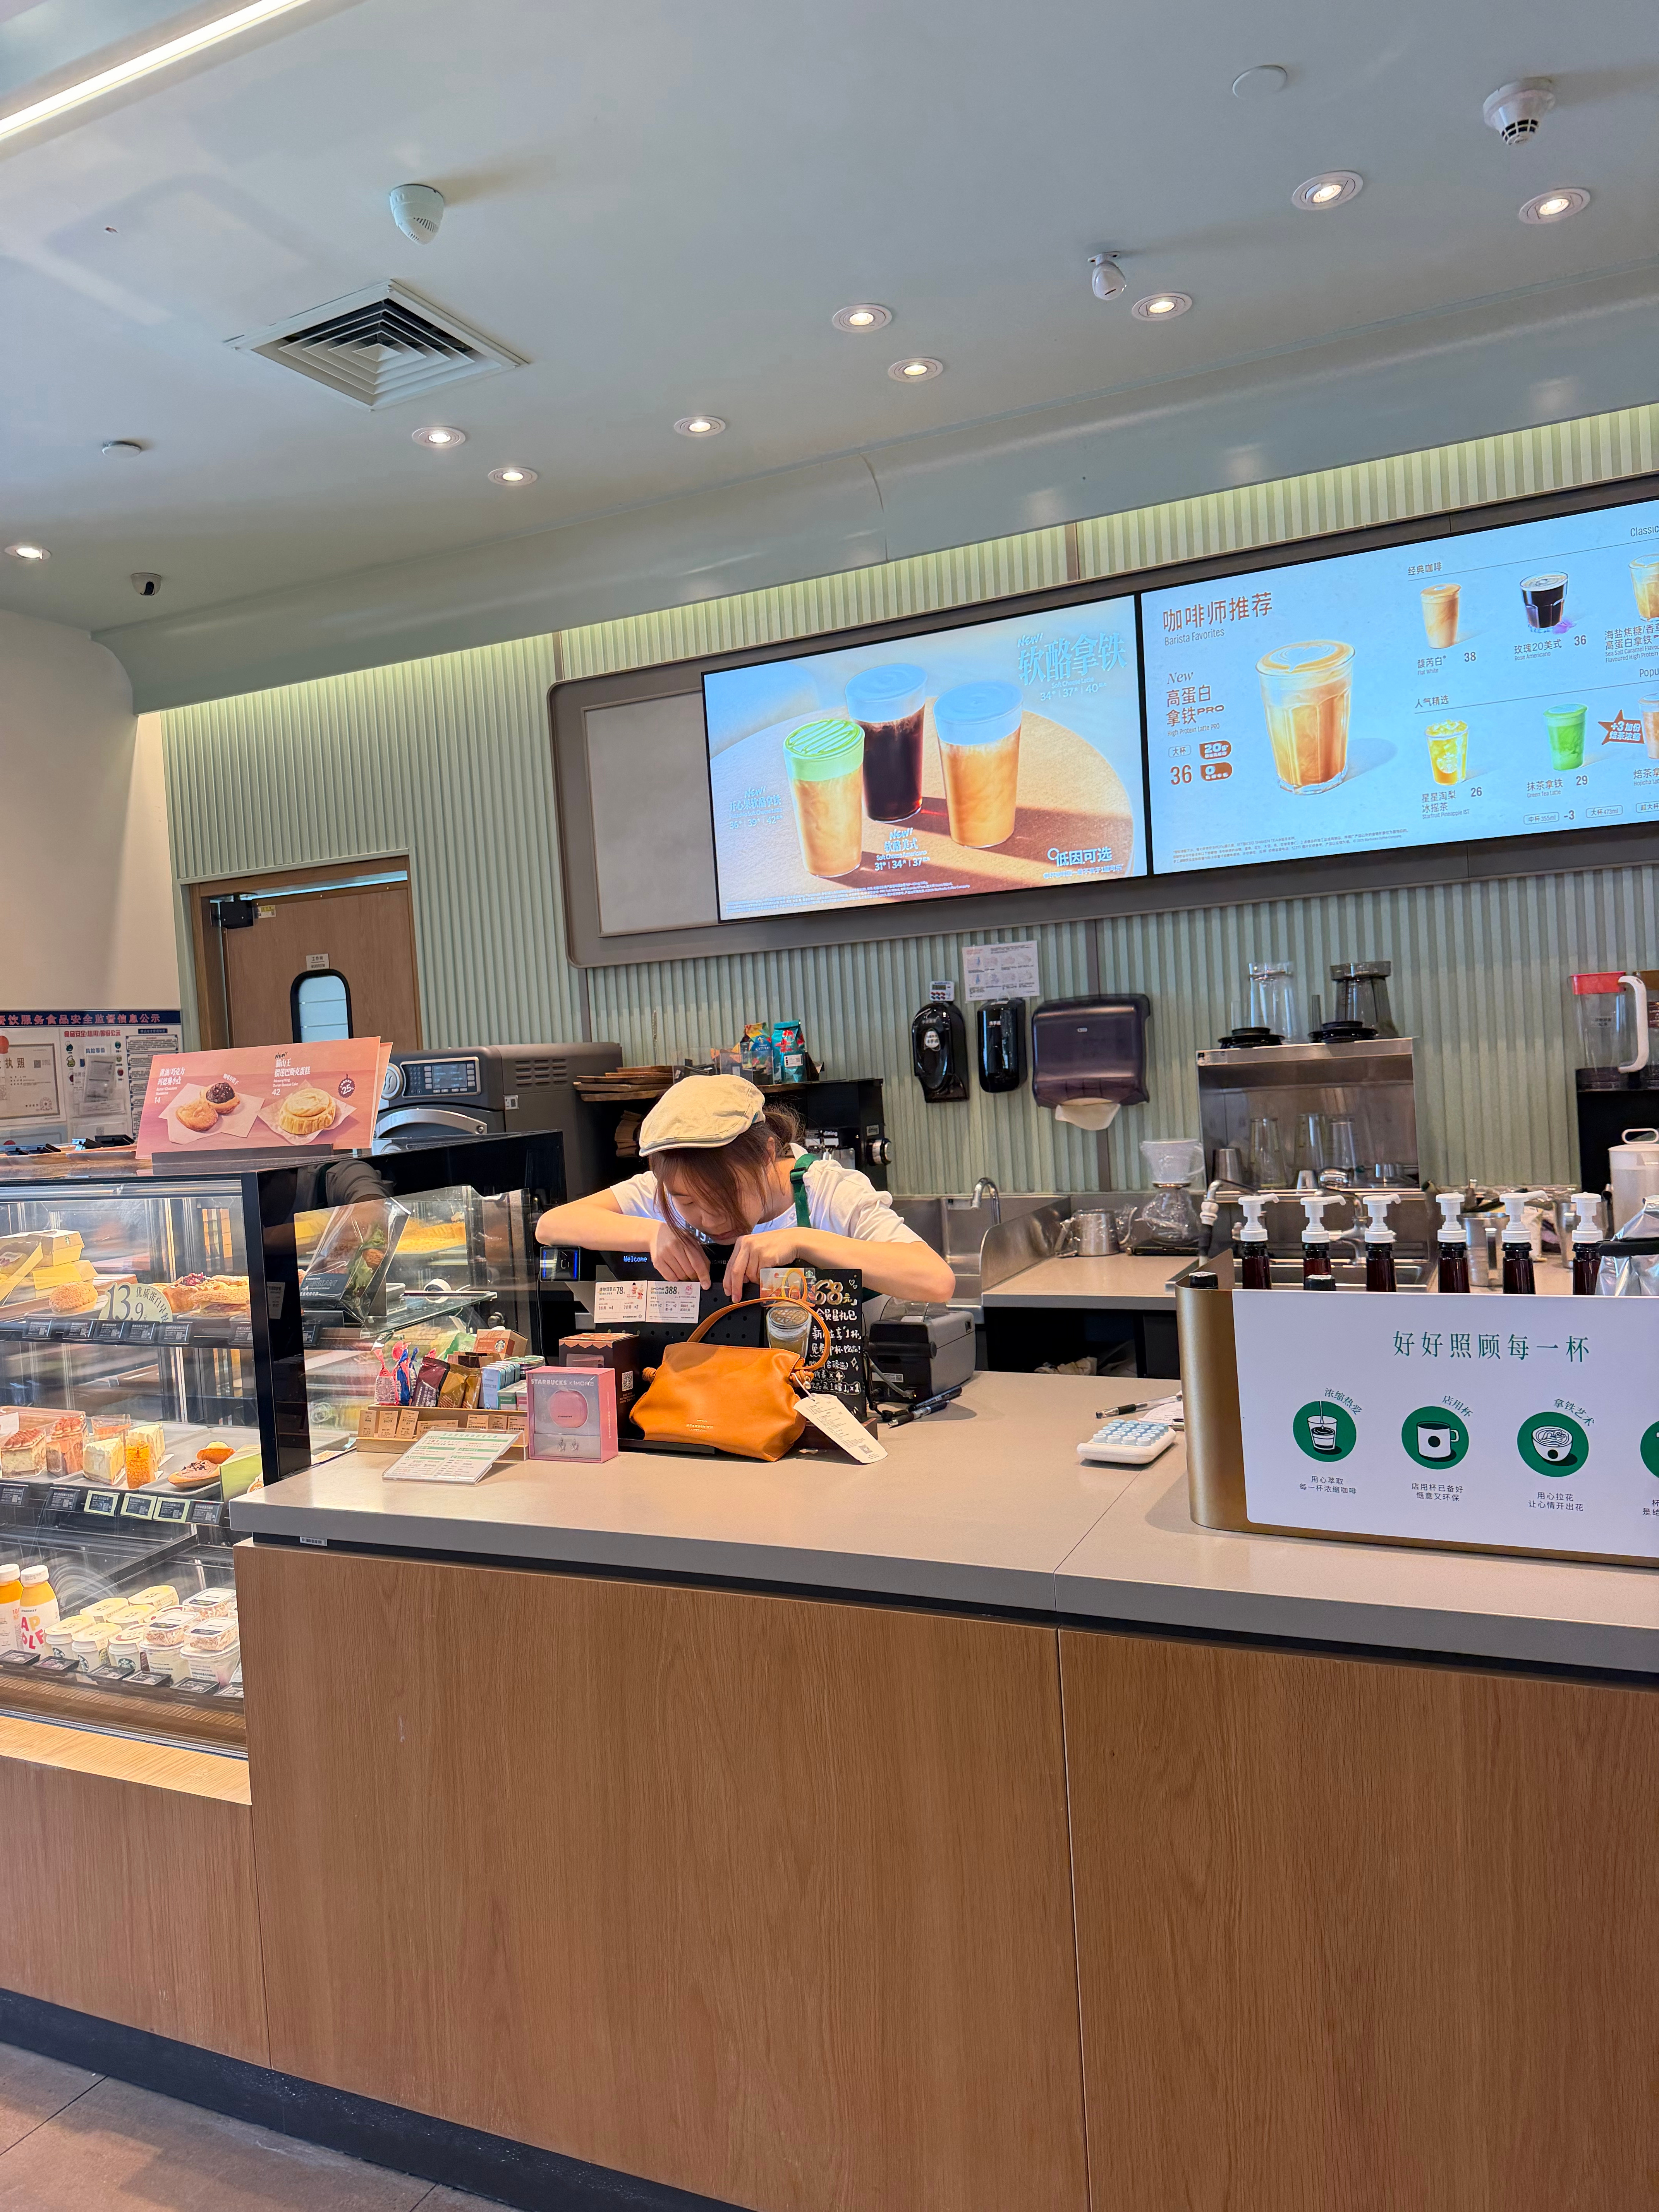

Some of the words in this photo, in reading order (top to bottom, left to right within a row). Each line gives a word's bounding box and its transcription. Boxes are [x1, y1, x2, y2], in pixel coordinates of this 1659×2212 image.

[1630, 525, 1659, 537] Classic
[1408, 562, 1442, 575] 经典咖啡
[1163, 592, 1272, 632] 咖啡师推荐
[1017, 632, 1043, 647] NEW!
[1165, 634, 1190, 646] Barista
[1192, 629, 1225, 641] Favorites
[1574, 635, 1587, 646] 36
[1514, 639, 1562, 654] 玫瑰20美式
[1018, 632, 1128, 686] 软酪拿铁
[1464, 651, 1476, 662] 38
[1526, 651, 1551, 659] Americano
[1167, 672, 1194, 684] New
[1166, 684, 1211, 708] 高蛋白
[1415, 695, 1449, 709] 人气精选
[1166, 704, 1224, 727] 拿铁PRO
[1168, 729, 1178, 737] High
[1173, 747, 1187, 756] 大杯
[1170, 764, 1192, 785] 36
[1576, 775, 1588, 786] 29
[1527, 778, 1563, 791] 抹茶拿铁
[745, 786, 766, 798] NEW!
[1470, 787, 1482, 797] 26
[1422, 802, 1448, 813] 冰摇茶
[1564, 810, 1575, 820] -3
[889, 827, 913, 840] NEW!
[884, 838, 918, 853] 软酪美式
[275, 1058, 291, 1068] 猫山王
[159, 1067, 185, 1077] 黄油/巧克力
[275, 1066, 310, 1077] 榴莲巴斯克蛋糕
[1393, 1331, 1590, 1363] 好好照顾每一杯
[1324, 1388, 1363, 1415] 浓缩热爱
[1442, 1395, 1473, 1417] 店用杯
[1554, 1398, 1595, 1427] 拿铁艺术
[1311, 1475, 1343, 1485] 用心萃取
[1299, 1483, 1357, 1495] 每一杯浓缩咖啡
[1412, 1483, 1463, 1493] 店用杯已备好
[1416, 1492, 1460, 1501] 惬意又环保
[1537, 1492, 1573, 1501] 用心拉花
[1528, 1500, 1583, 1511] 让心情开出花
